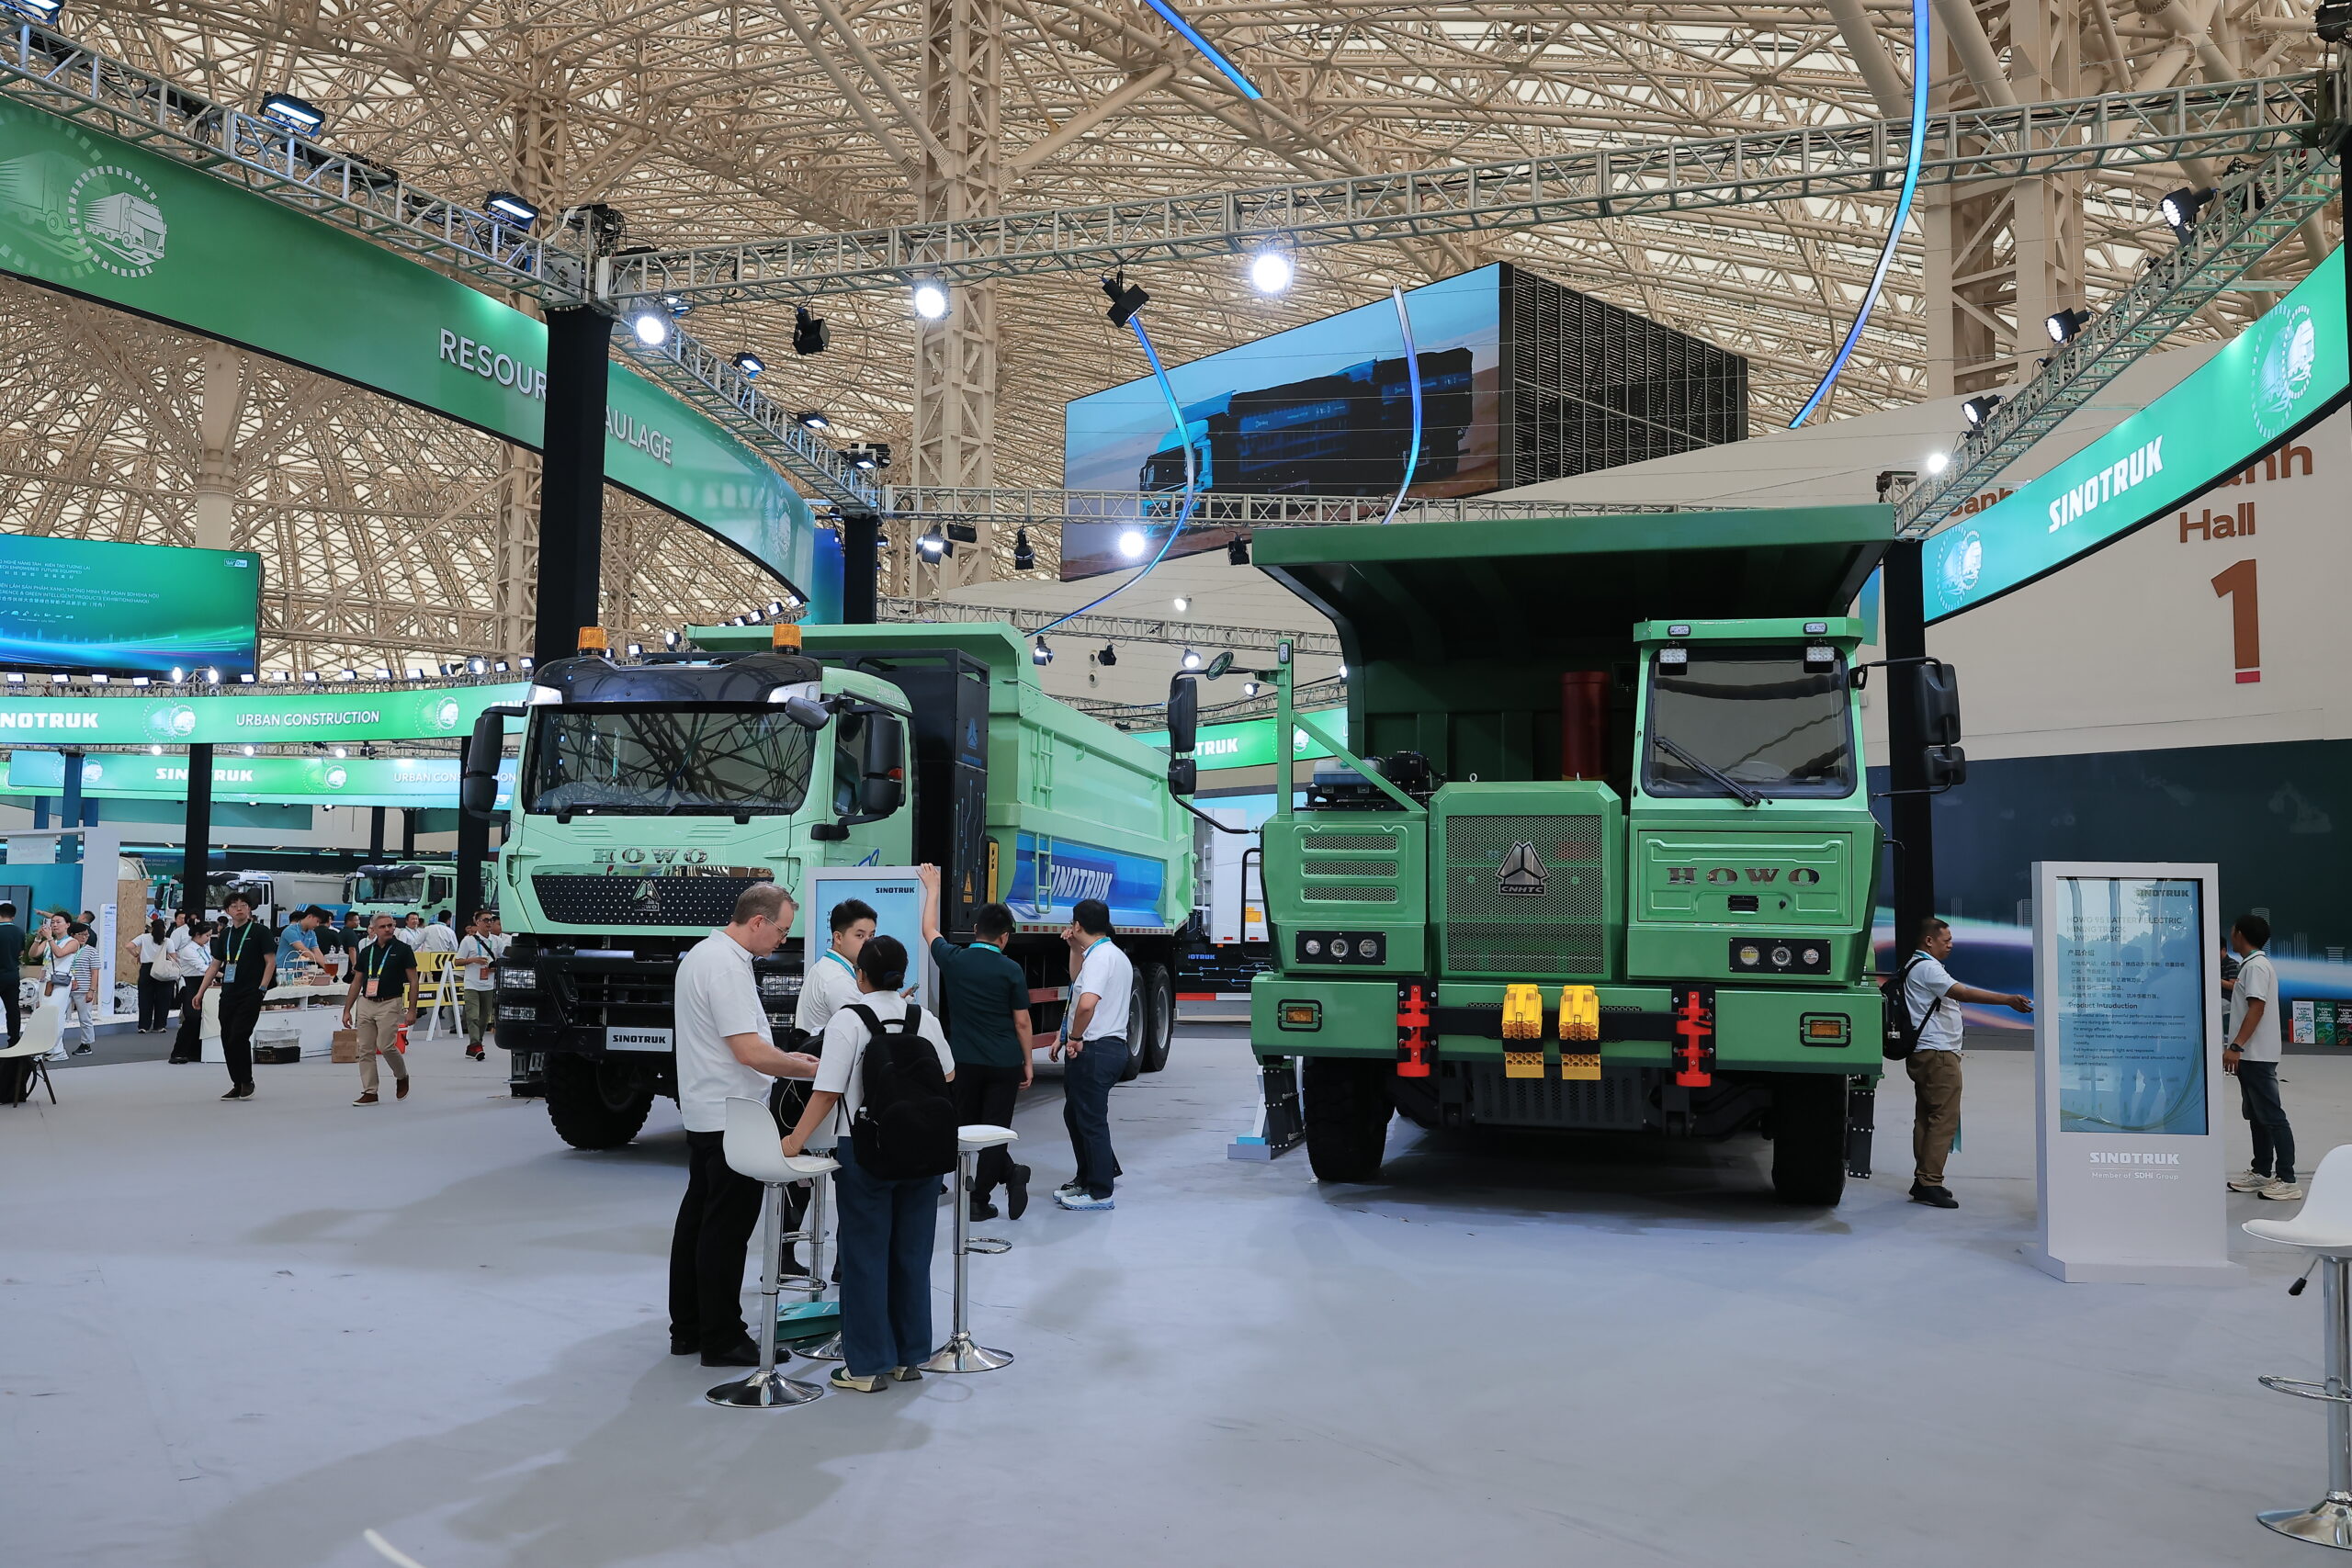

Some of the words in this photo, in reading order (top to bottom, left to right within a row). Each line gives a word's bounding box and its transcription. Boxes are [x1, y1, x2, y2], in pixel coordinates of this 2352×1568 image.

[439, 328, 548, 401] RESOUR
[605, 405, 673, 465] AULAGE
[2049, 434, 2163, 534] SINOTRUK
[2180, 502, 2256, 543] Hall
[2211, 558, 2260, 669] 1
[0, 712, 98, 728] NOTRUK
[235, 713, 280, 728] URBAN
[283, 710, 380, 727] CONSTRUCTION
[1192, 738, 1238, 757] TRUK
[155, 767, 254, 782] SINRUK
[394, 773, 432, 782] URBAN
[433, 773, 516, 783] CONSION
[593, 847, 707, 863] HOWO
[1667, 867, 1820, 886] HOWO
[2136, 889, 2190, 897] SINOTRUK
[613, 1034, 666, 1043] SINOTRUK
[2089, 1152, 2180, 1165] SINOTRUK
